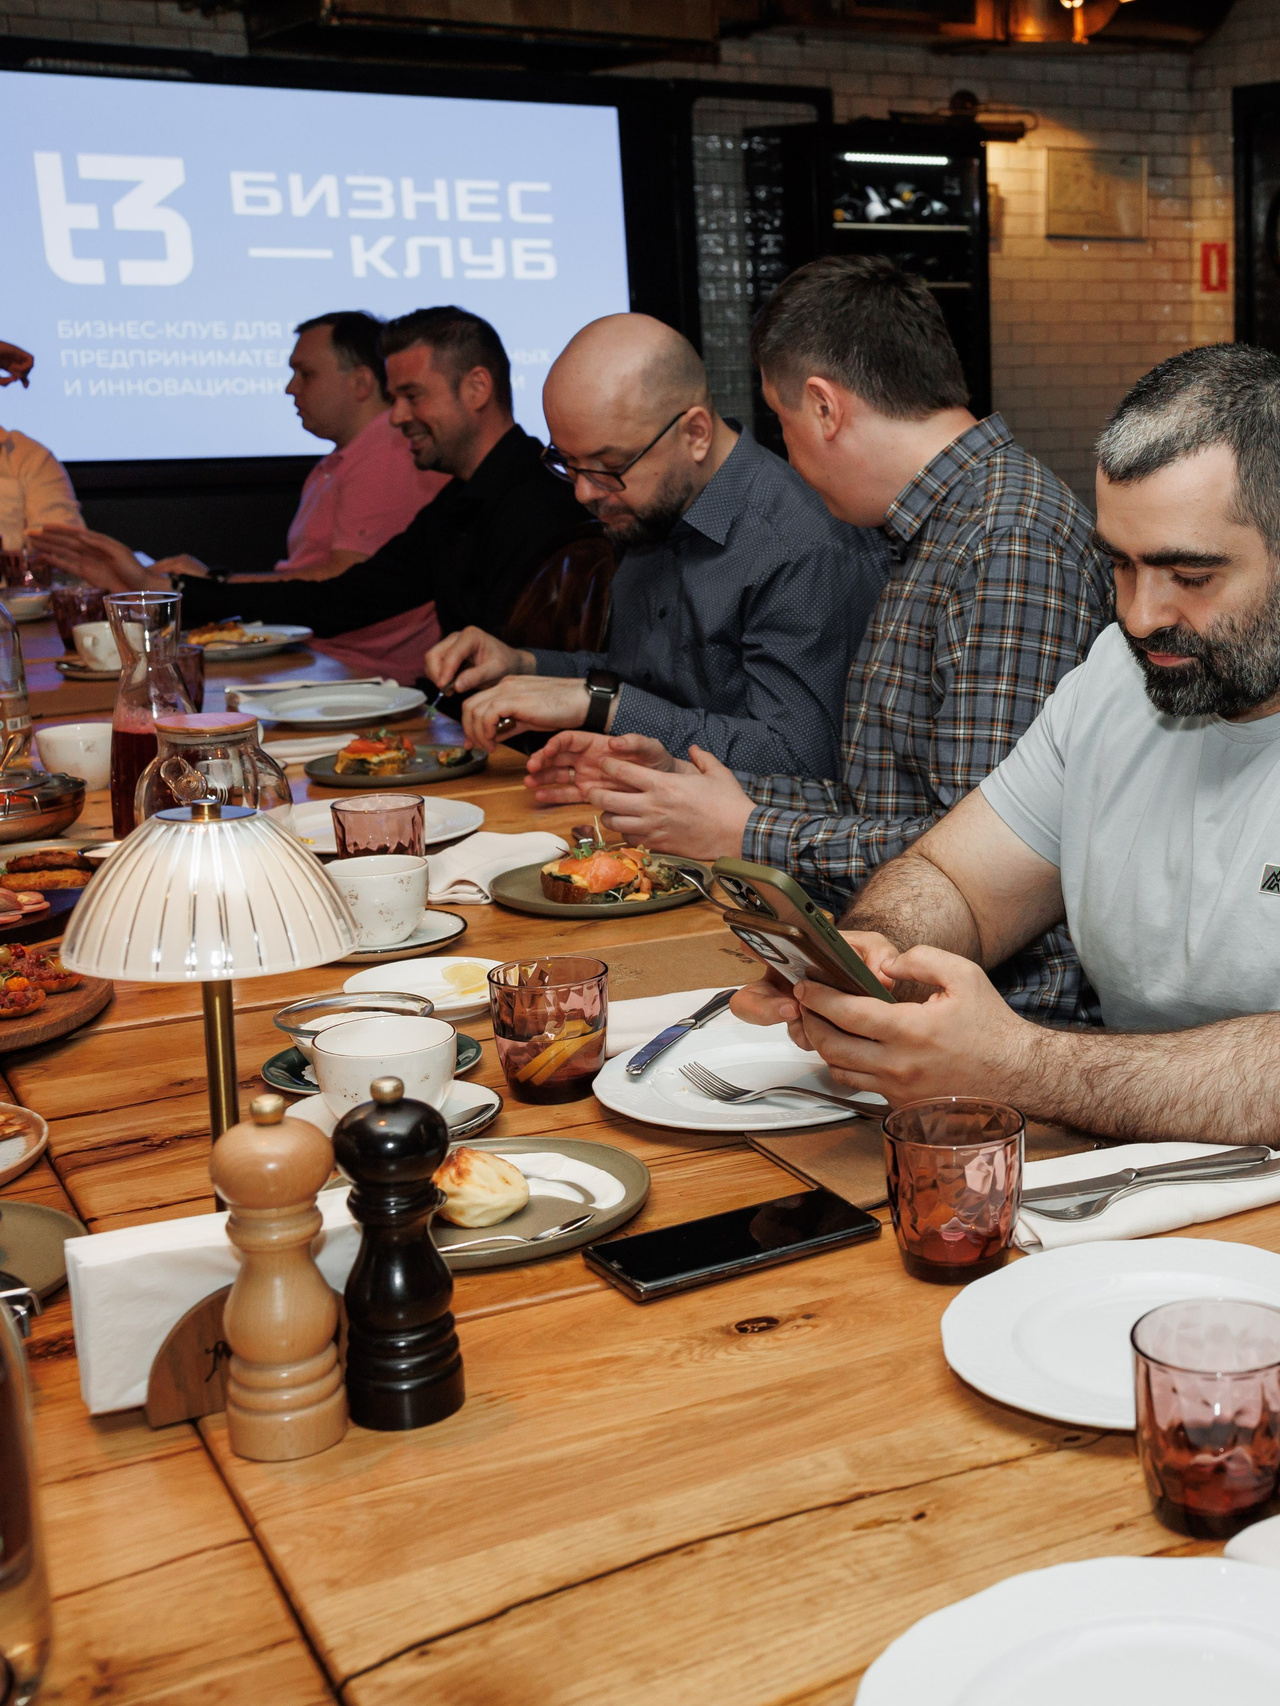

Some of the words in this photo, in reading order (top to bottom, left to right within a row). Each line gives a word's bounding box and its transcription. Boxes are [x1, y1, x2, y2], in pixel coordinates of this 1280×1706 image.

[229, 170, 554, 224] БИЗНЕС
[350, 234, 558, 280] КЛУБ
[56, 319, 229, 340] БИЗНЕС-КЛУБ
[232, 320, 283, 341] ДЛЯ
[60, 348, 291, 370] ПРЕДПРИНИМАТЕЛ
[63, 378, 82, 397] И
[88, 377, 288, 398] ИННОВАЦИОНН
